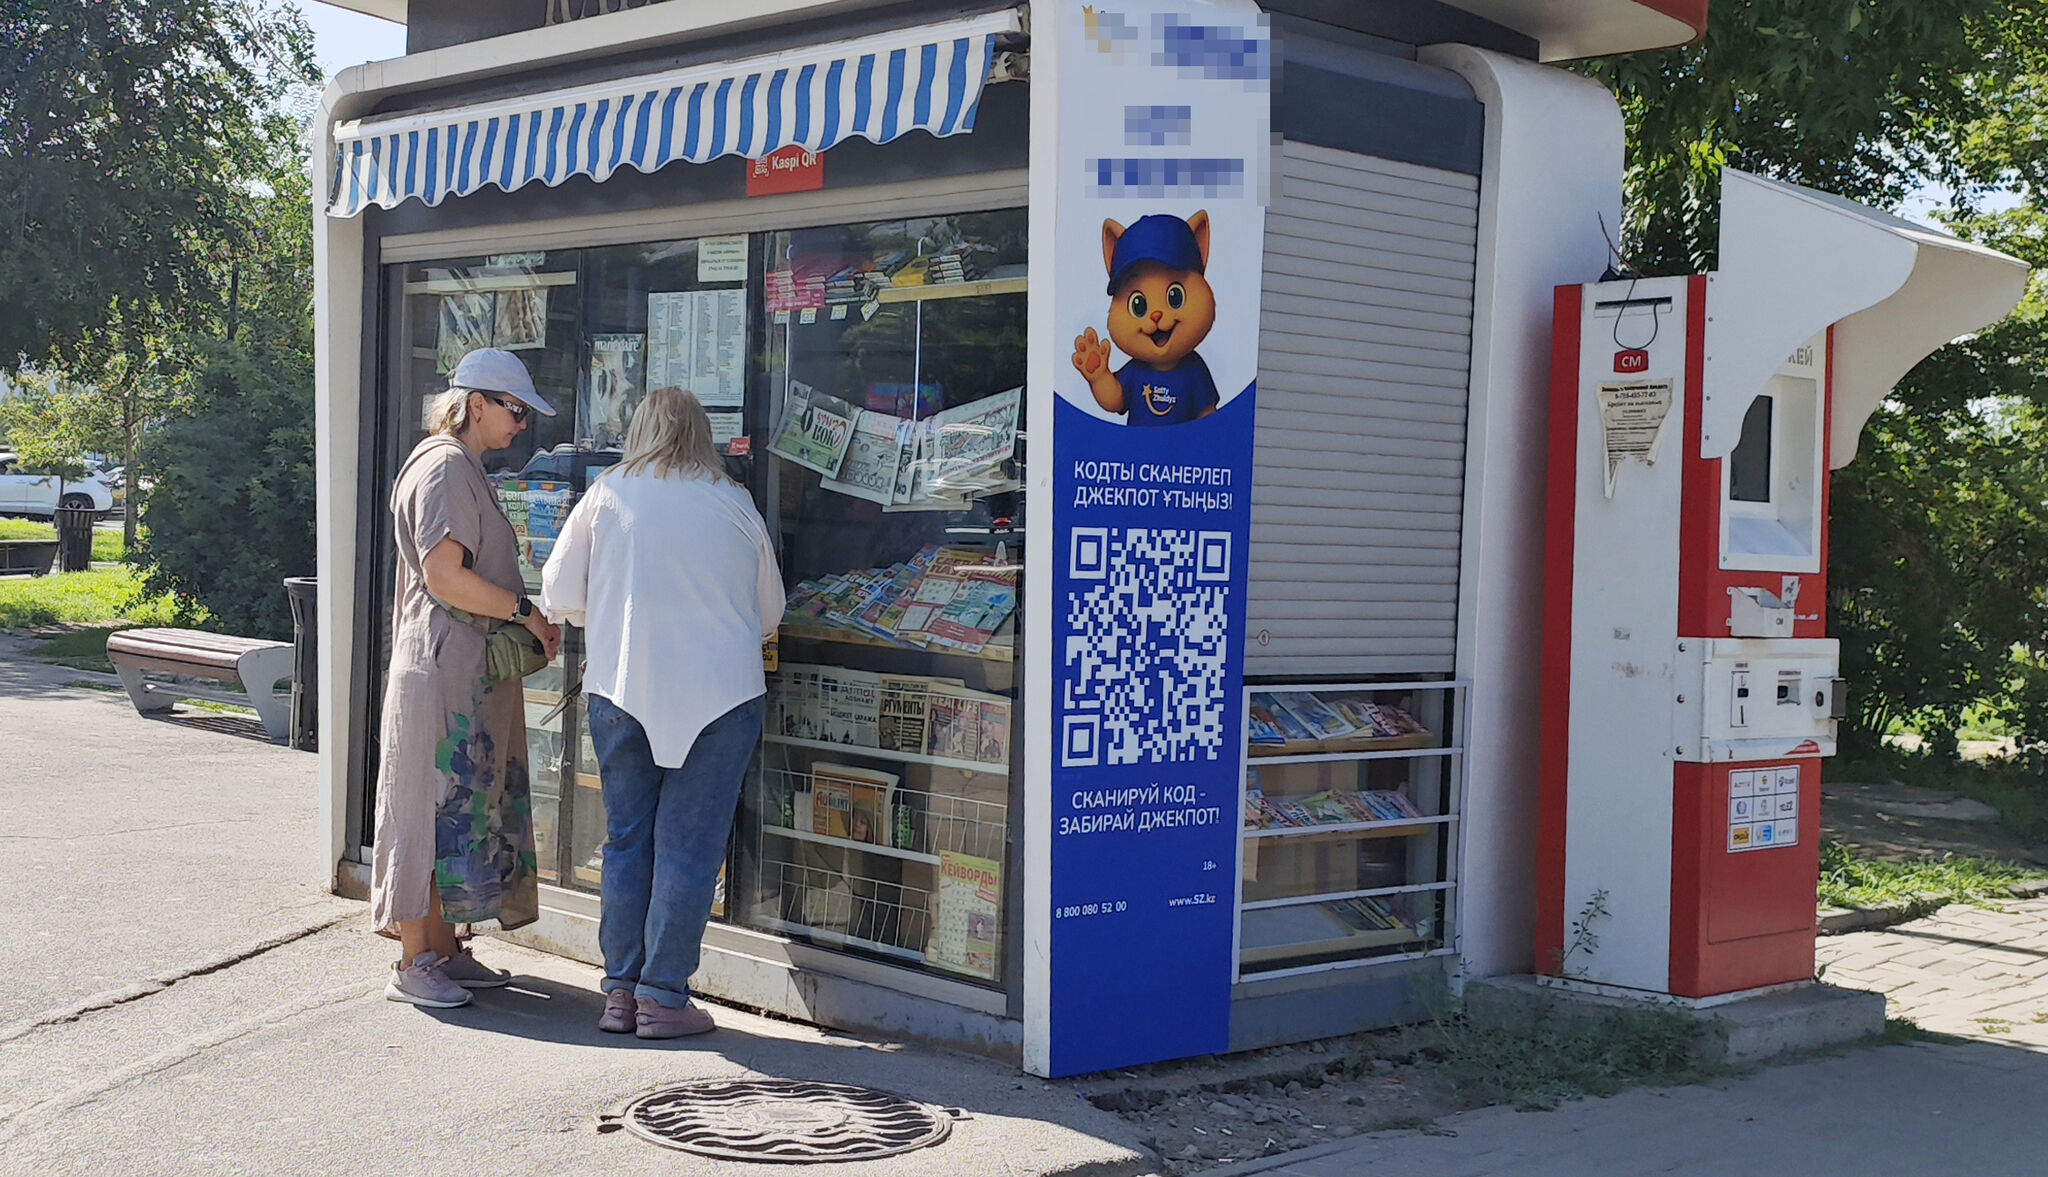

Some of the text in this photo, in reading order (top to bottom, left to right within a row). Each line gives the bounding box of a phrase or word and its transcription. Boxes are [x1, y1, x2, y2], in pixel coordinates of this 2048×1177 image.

[772, 152, 817, 172] Kaspi QR
[1153, 386, 1170, 395] Satty
[1074, 460, 1231, 487] КОДТЫ СКАНЕРЛЕП
[1073, 486, 1233, 513] ДЖЕКПОТ ҰТЫҢЫЗ!
[1072, 783, 1159, 809] СКАНИРУЙ
[1059, 807, 1220, 835] ЗАБИРАЙ ДЖЕКПОТ!
[941, 862, 997, 890] КЕЙВОРДЫ
[1202, 861, 1217, 871] 18+
[1056, 901, 1127, 919] 8 800 080 52 00
